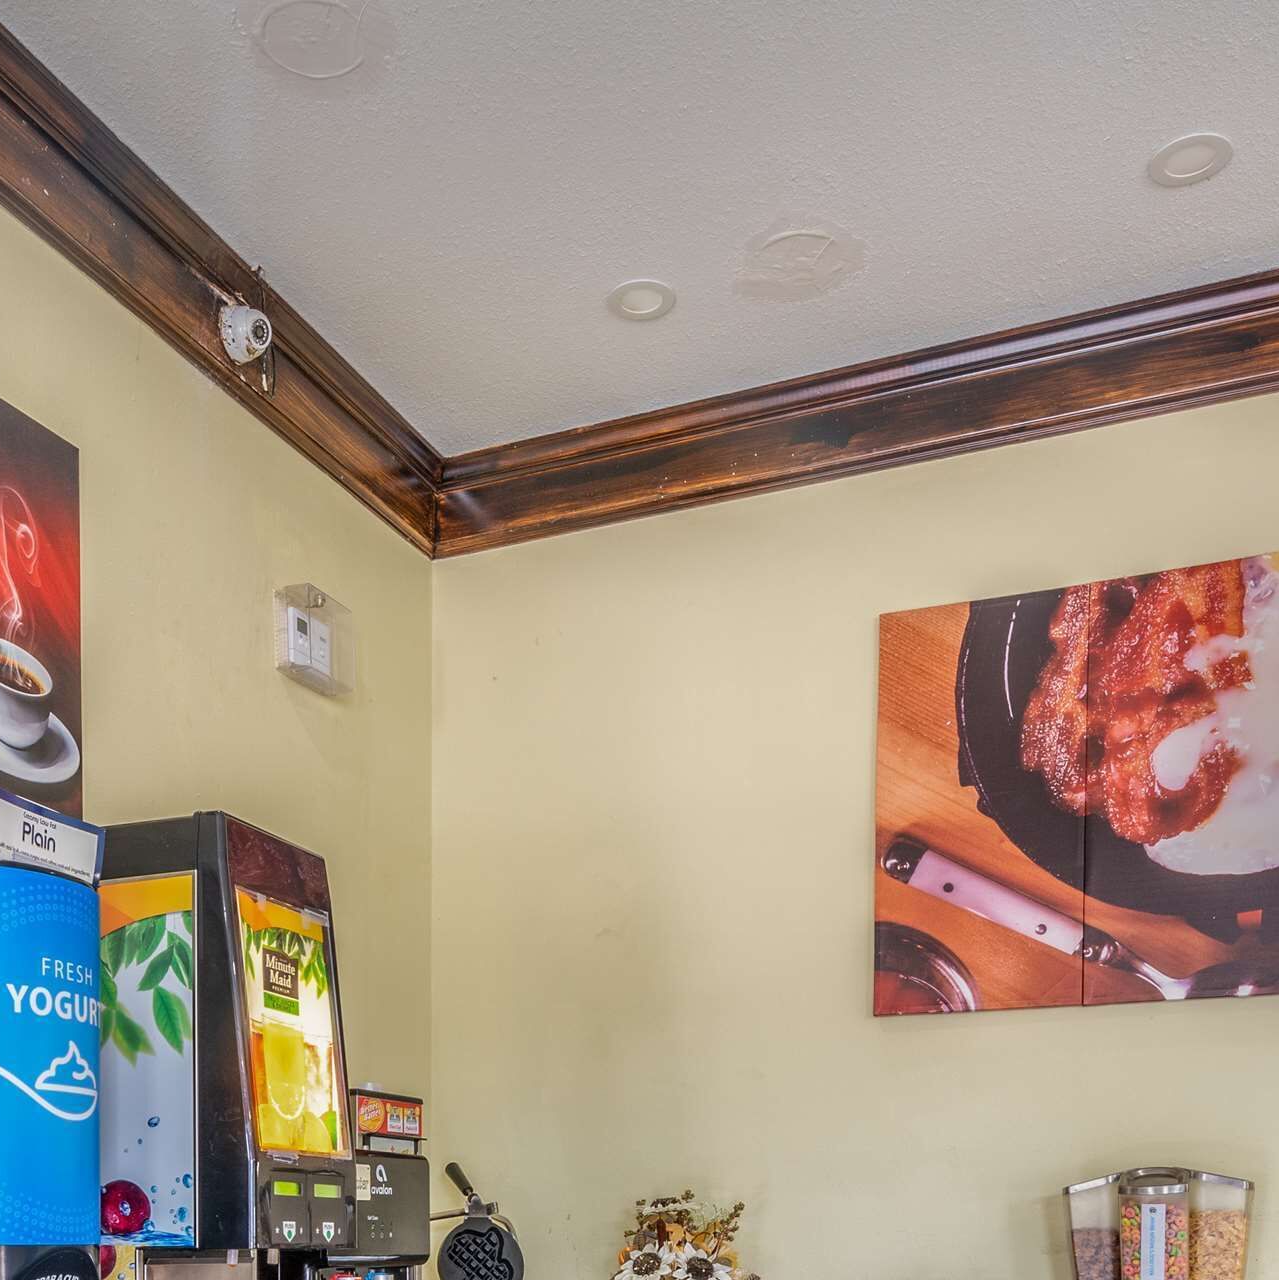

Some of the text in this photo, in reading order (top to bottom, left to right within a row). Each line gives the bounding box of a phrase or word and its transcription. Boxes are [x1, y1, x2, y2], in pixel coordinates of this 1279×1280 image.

[21, 821, 56, 853] Plain
[41, 956, 93, 987] FRESH
[265, 953, 296, 976] Minute
[269, 969, 292, 989] Maid
[370, 1183, 393, 1196] avalon
